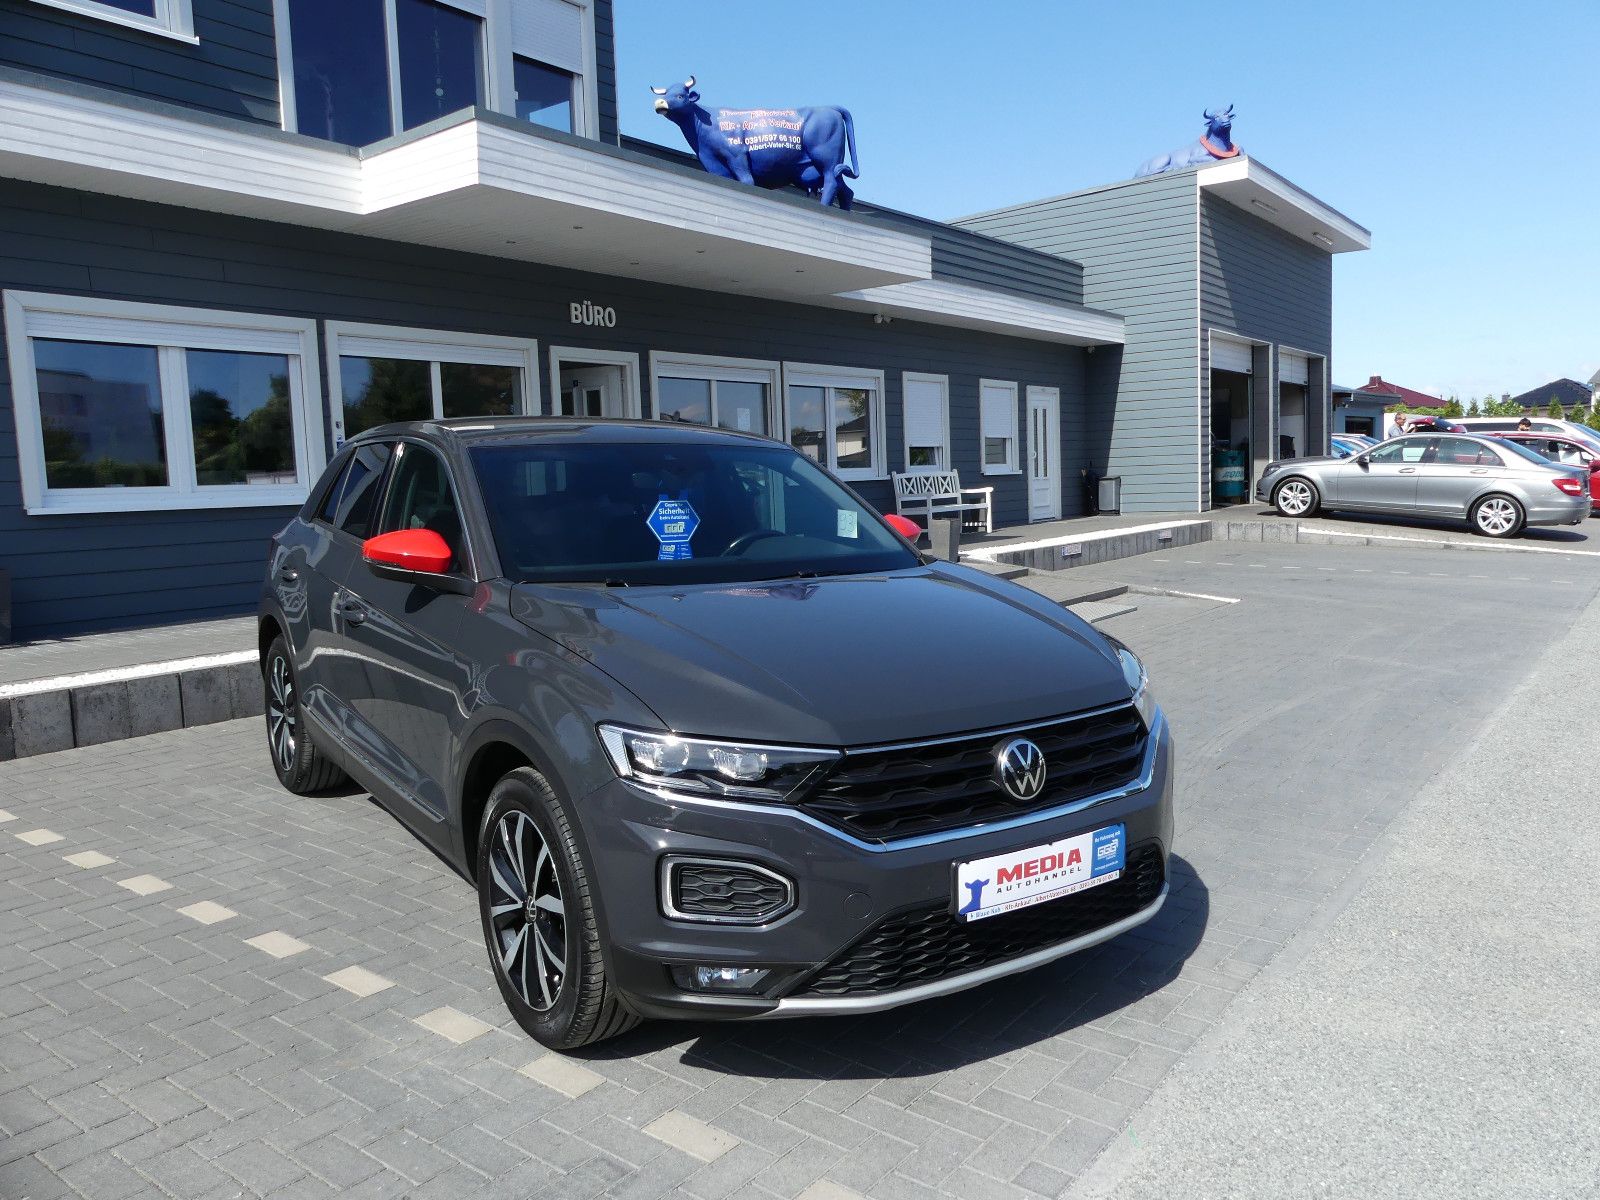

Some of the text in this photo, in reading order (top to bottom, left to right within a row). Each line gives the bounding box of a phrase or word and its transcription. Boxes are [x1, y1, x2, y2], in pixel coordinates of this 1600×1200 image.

[728, 137, 743, 146] Tel.
[789, 135, 801, 144] 100
[570, 300, 617, 328] BÜRO
[996, 848, 1082, 885] MEDIA
[996, 866, 1082, 894] AUTOHANDEL
